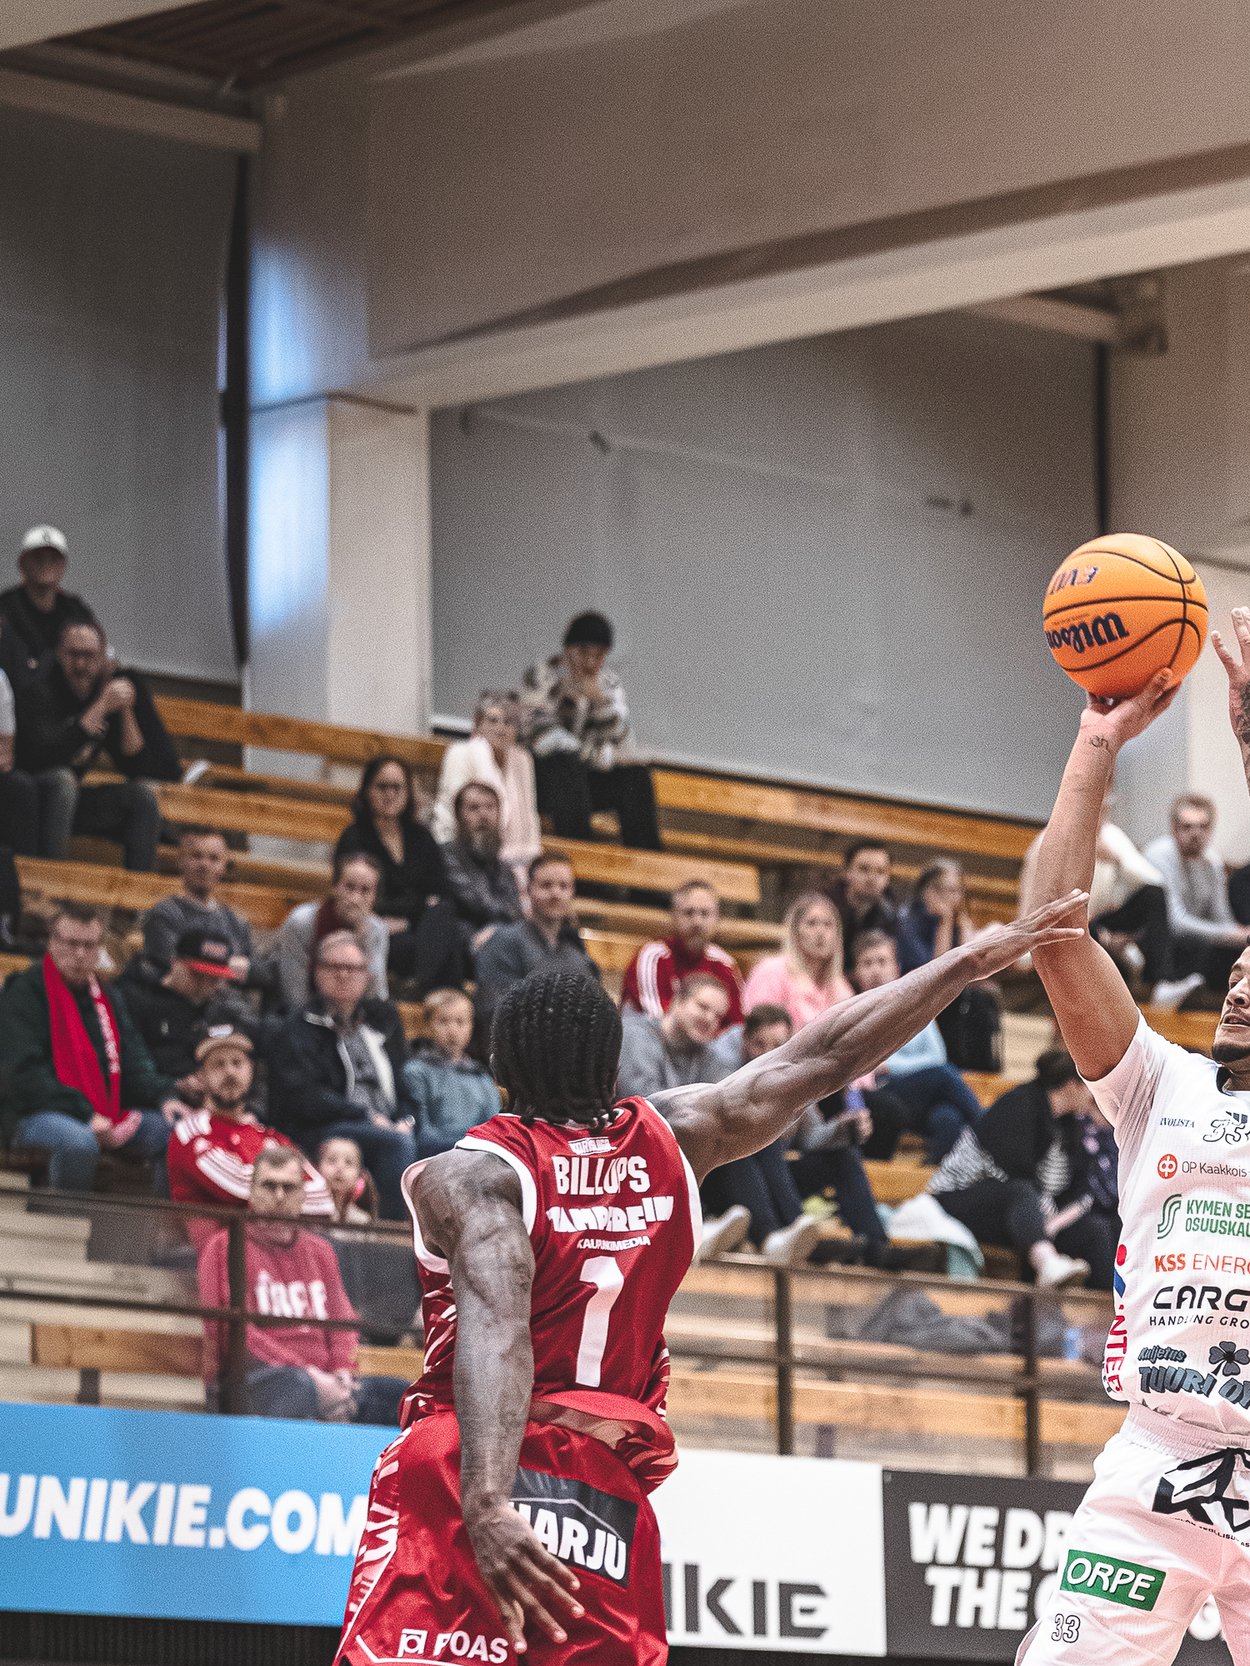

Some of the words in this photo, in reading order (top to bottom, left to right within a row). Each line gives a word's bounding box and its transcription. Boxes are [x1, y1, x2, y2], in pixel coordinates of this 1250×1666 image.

[1044, 612, 1130, 654] Wilson
[551, 1155, 651, 1196] BILLUPS
[1182, 1160, 1197, 1174] OP
[1186, 1199, 1233, 1218] KYMEN
[1154, 1252, 1187, 1273] KSS
[576, 1255, 625, 1388] 1
[1105, 1304, 1128, 1393] NTER
[1139, 1365, 1218, 1399] TUURI
[0, 1473, 371, 1557] UNIKIE.COM
[908, 1501, 997, 1567] WE
[925, 1567, 1032, 1630] THE
[1066, 1557, 1156, 1602] ORPE
[663, 1563, 830, 1640] IKIE
[433, 1630, 509, 1665] POAS
[1051, 1613, 1081, 1644] 33
